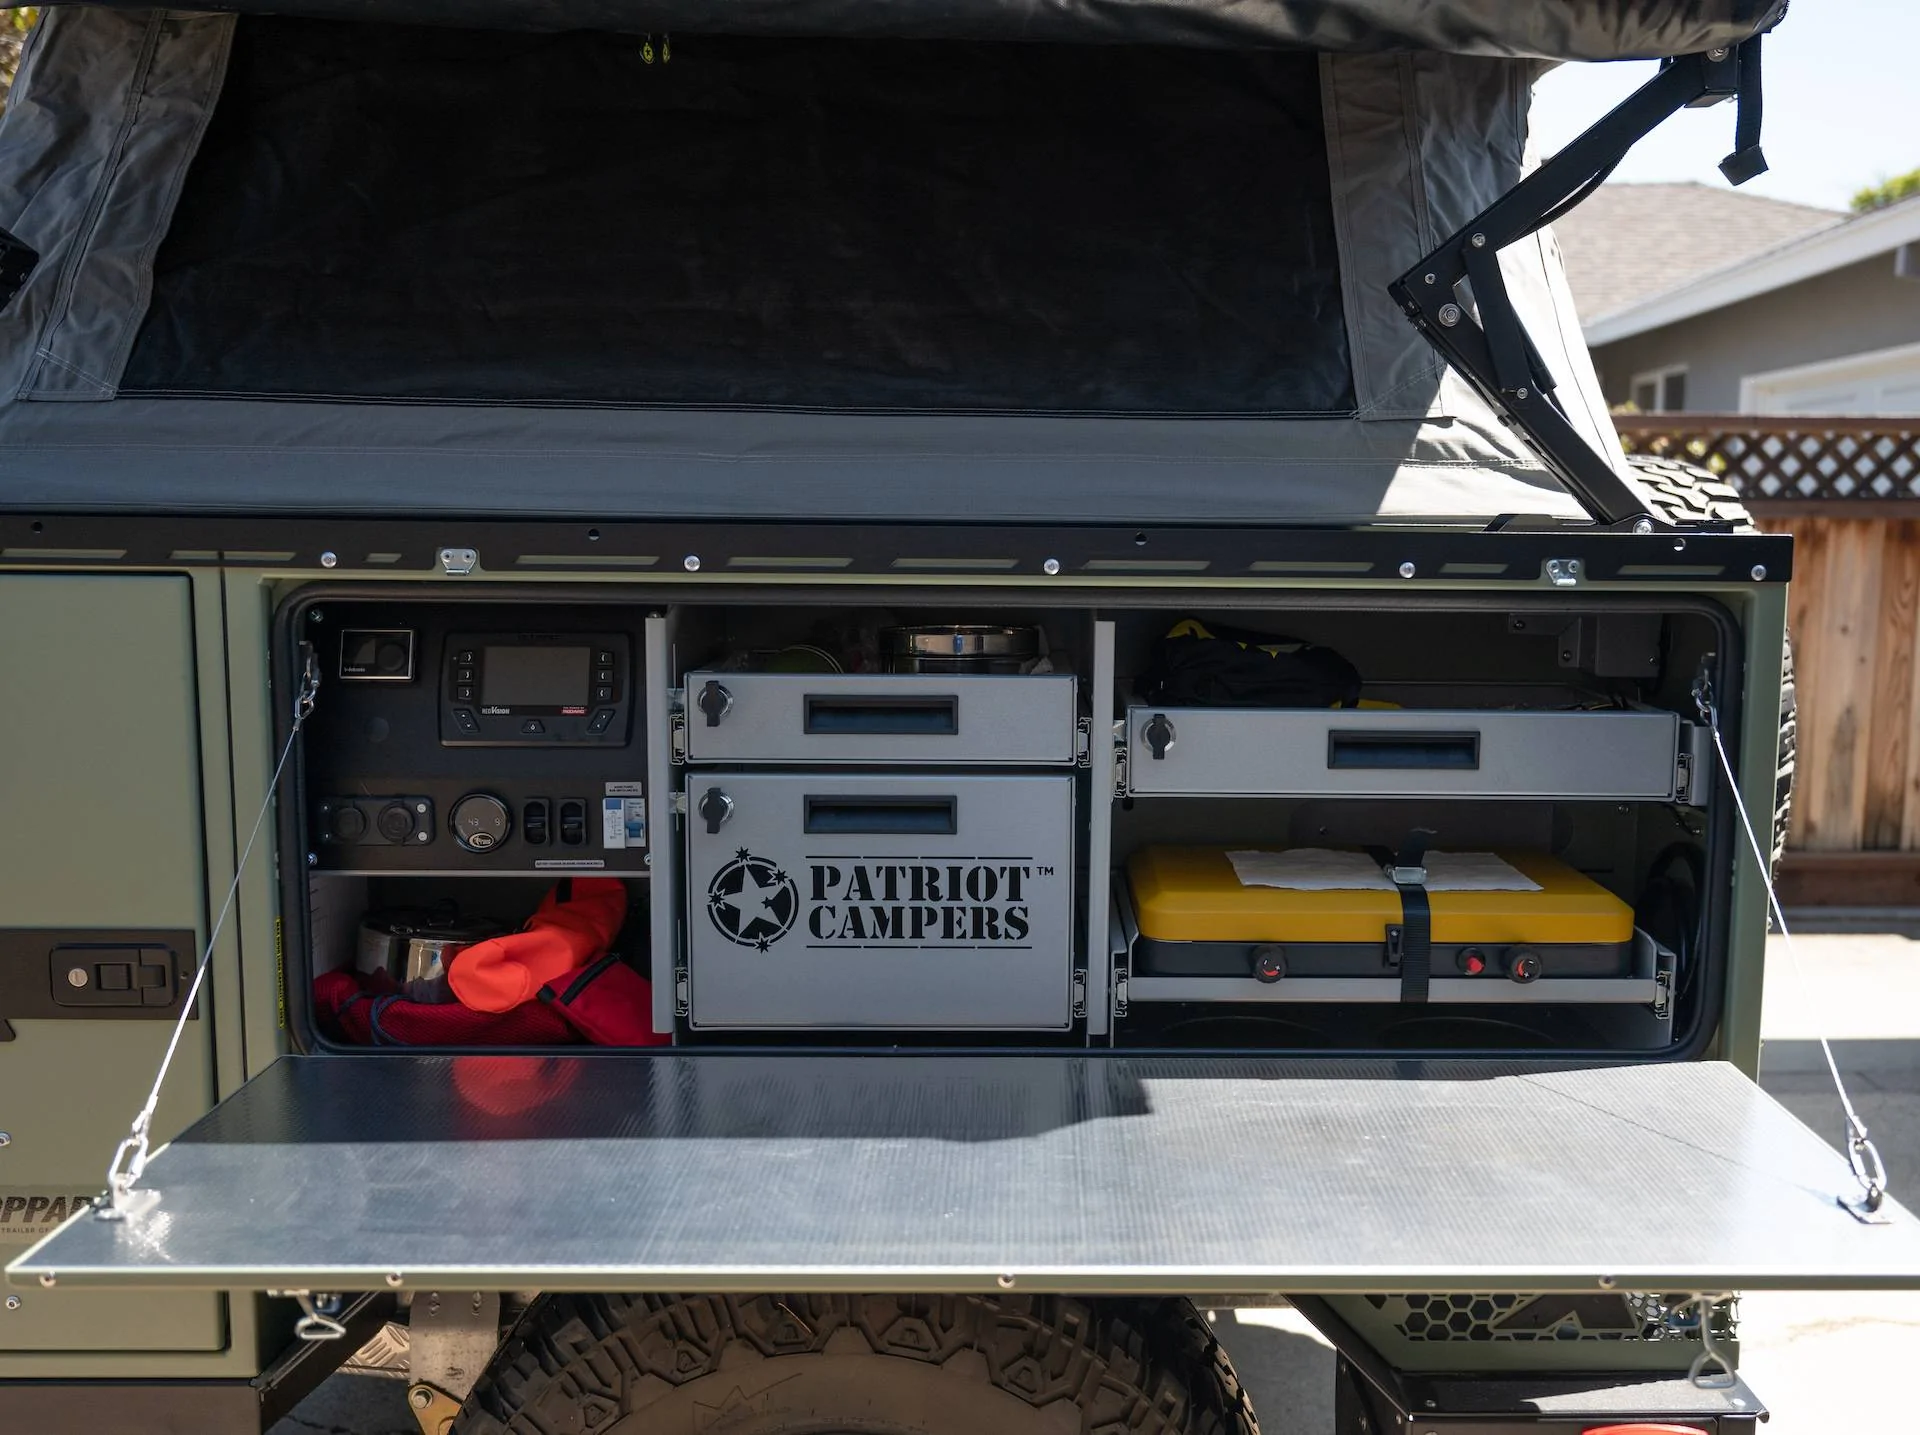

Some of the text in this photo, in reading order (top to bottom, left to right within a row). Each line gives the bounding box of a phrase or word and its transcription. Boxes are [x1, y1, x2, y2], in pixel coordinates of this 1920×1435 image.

[809, 865, 1054, 902] PATRIOT TM
[808, 905, 1030, 940] CAMPERS
